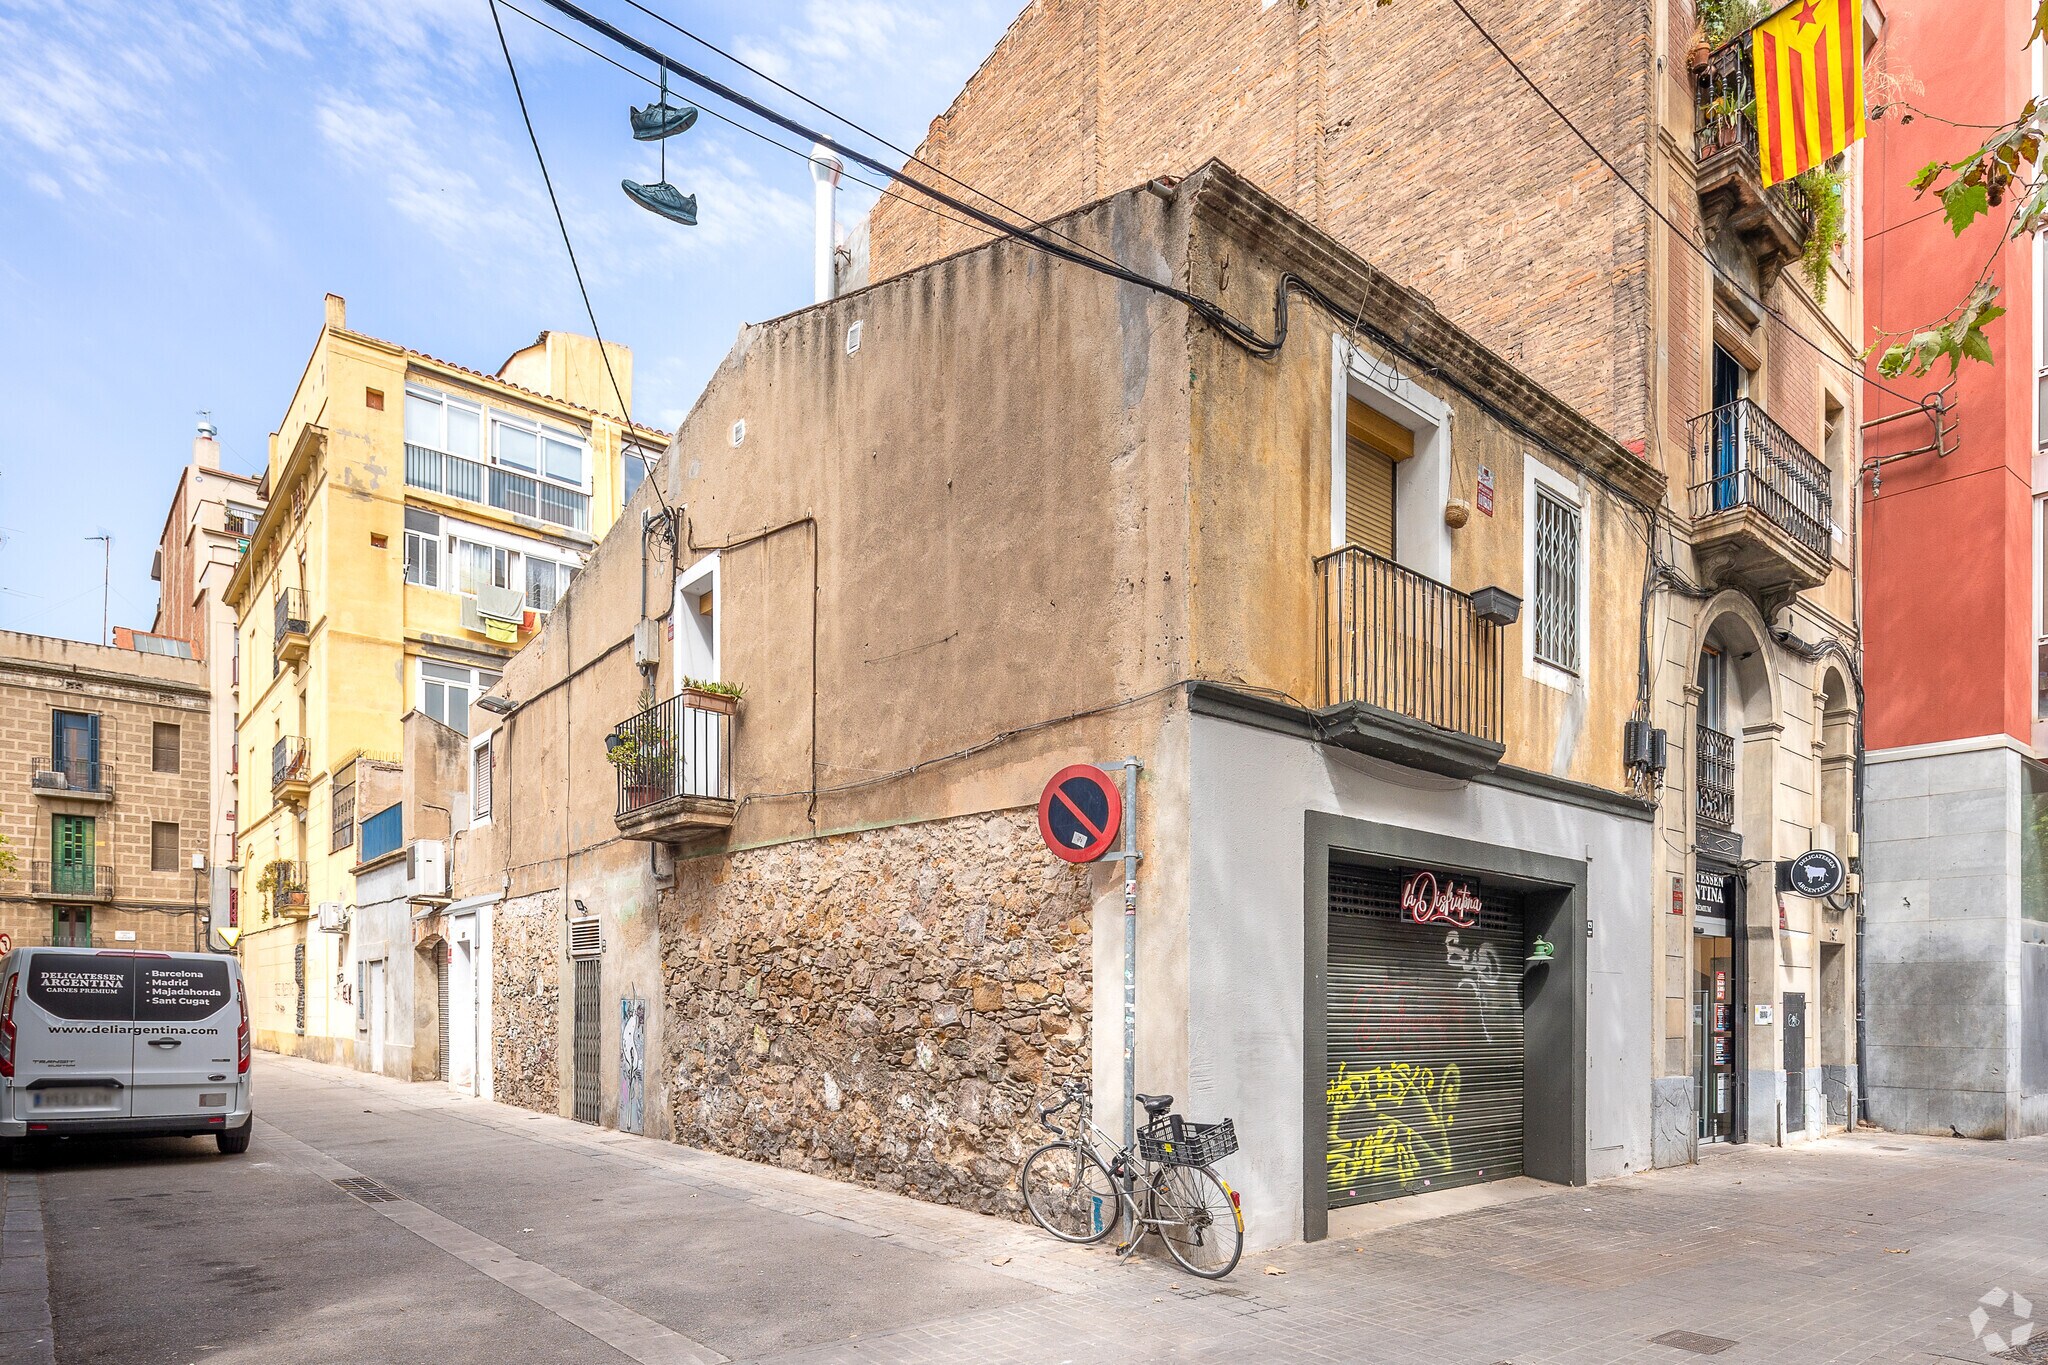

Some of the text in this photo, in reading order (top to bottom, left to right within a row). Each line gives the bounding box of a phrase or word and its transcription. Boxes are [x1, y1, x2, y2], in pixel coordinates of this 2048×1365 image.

[1798, 854, 1836, 869] DELICATESSEN
[1797, 881, 1831, 893] ARGENTINA
[1696, 884, 1724, 904] NTINA
[41, 972, 124, 981] DELICATESSEN
[151, 970, 204, 978] Barcelona
[41, 979, 124, 989] ARGENTINA
[152, 979, 189, 987] Madrid
[152, 988, 221, 997] Majadahonda
[152, 997, 210, 1006] Sant Cugat
[48, 1025, 218, 1036] www.deliargentina.com
